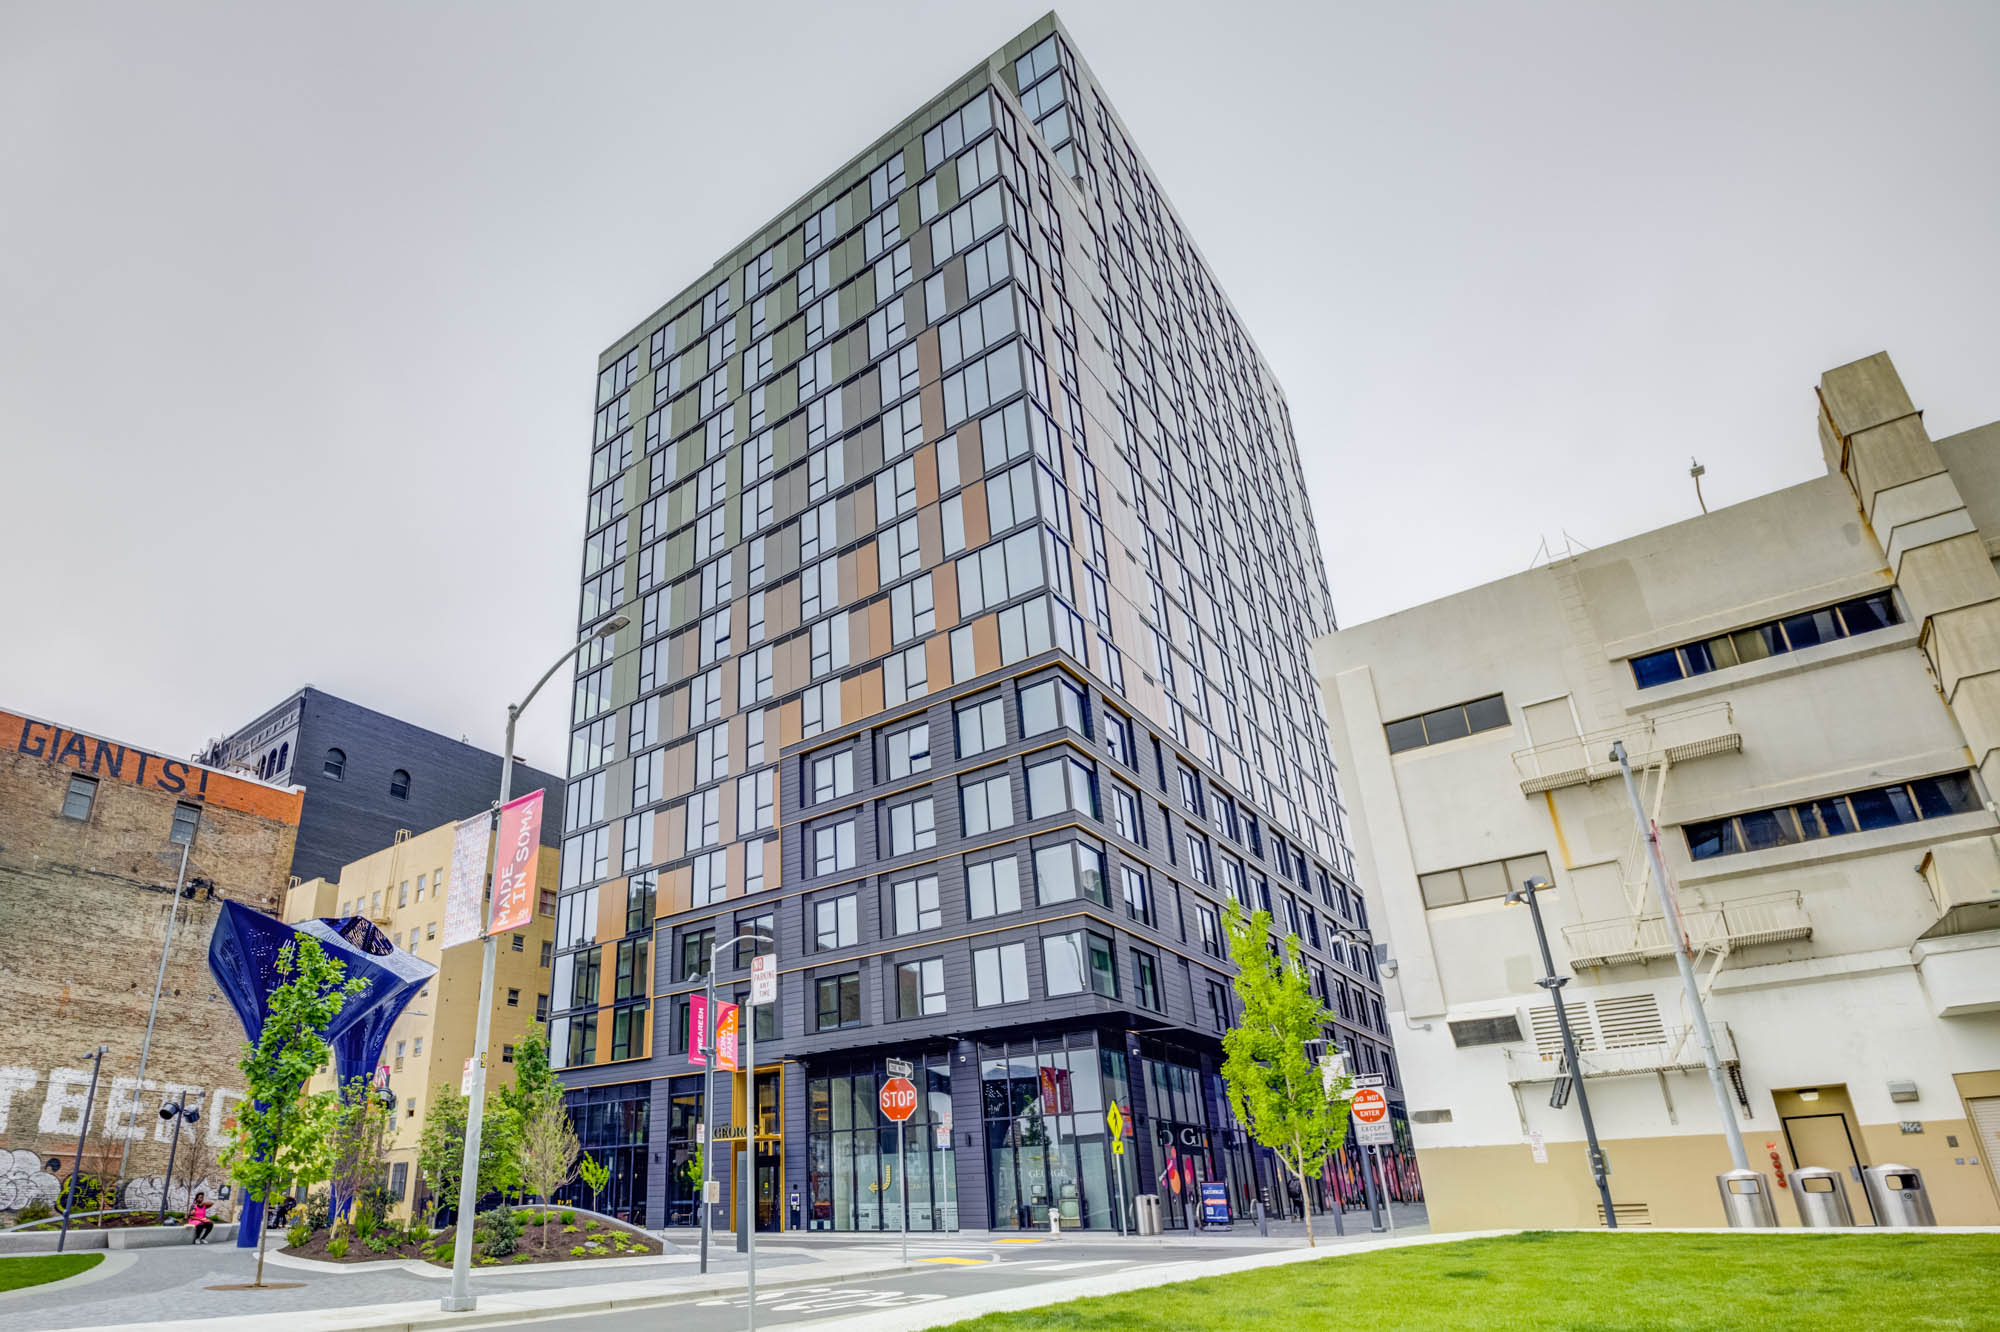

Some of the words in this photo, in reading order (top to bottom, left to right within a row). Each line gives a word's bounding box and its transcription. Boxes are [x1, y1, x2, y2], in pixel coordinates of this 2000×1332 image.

[18, 719, 208, 801] GIANTS!
[516, 801, 535, 863] SOMA
[498, 863, 514, 926] MADE
[513, 872, 527, 904] IN
[753, 959, 763, 970] NO
[753, 970, 775, 983] PARKING
[882, 1090, 915, 1108] STOP
[1028, 1167, 1069, 1178] GEGE
